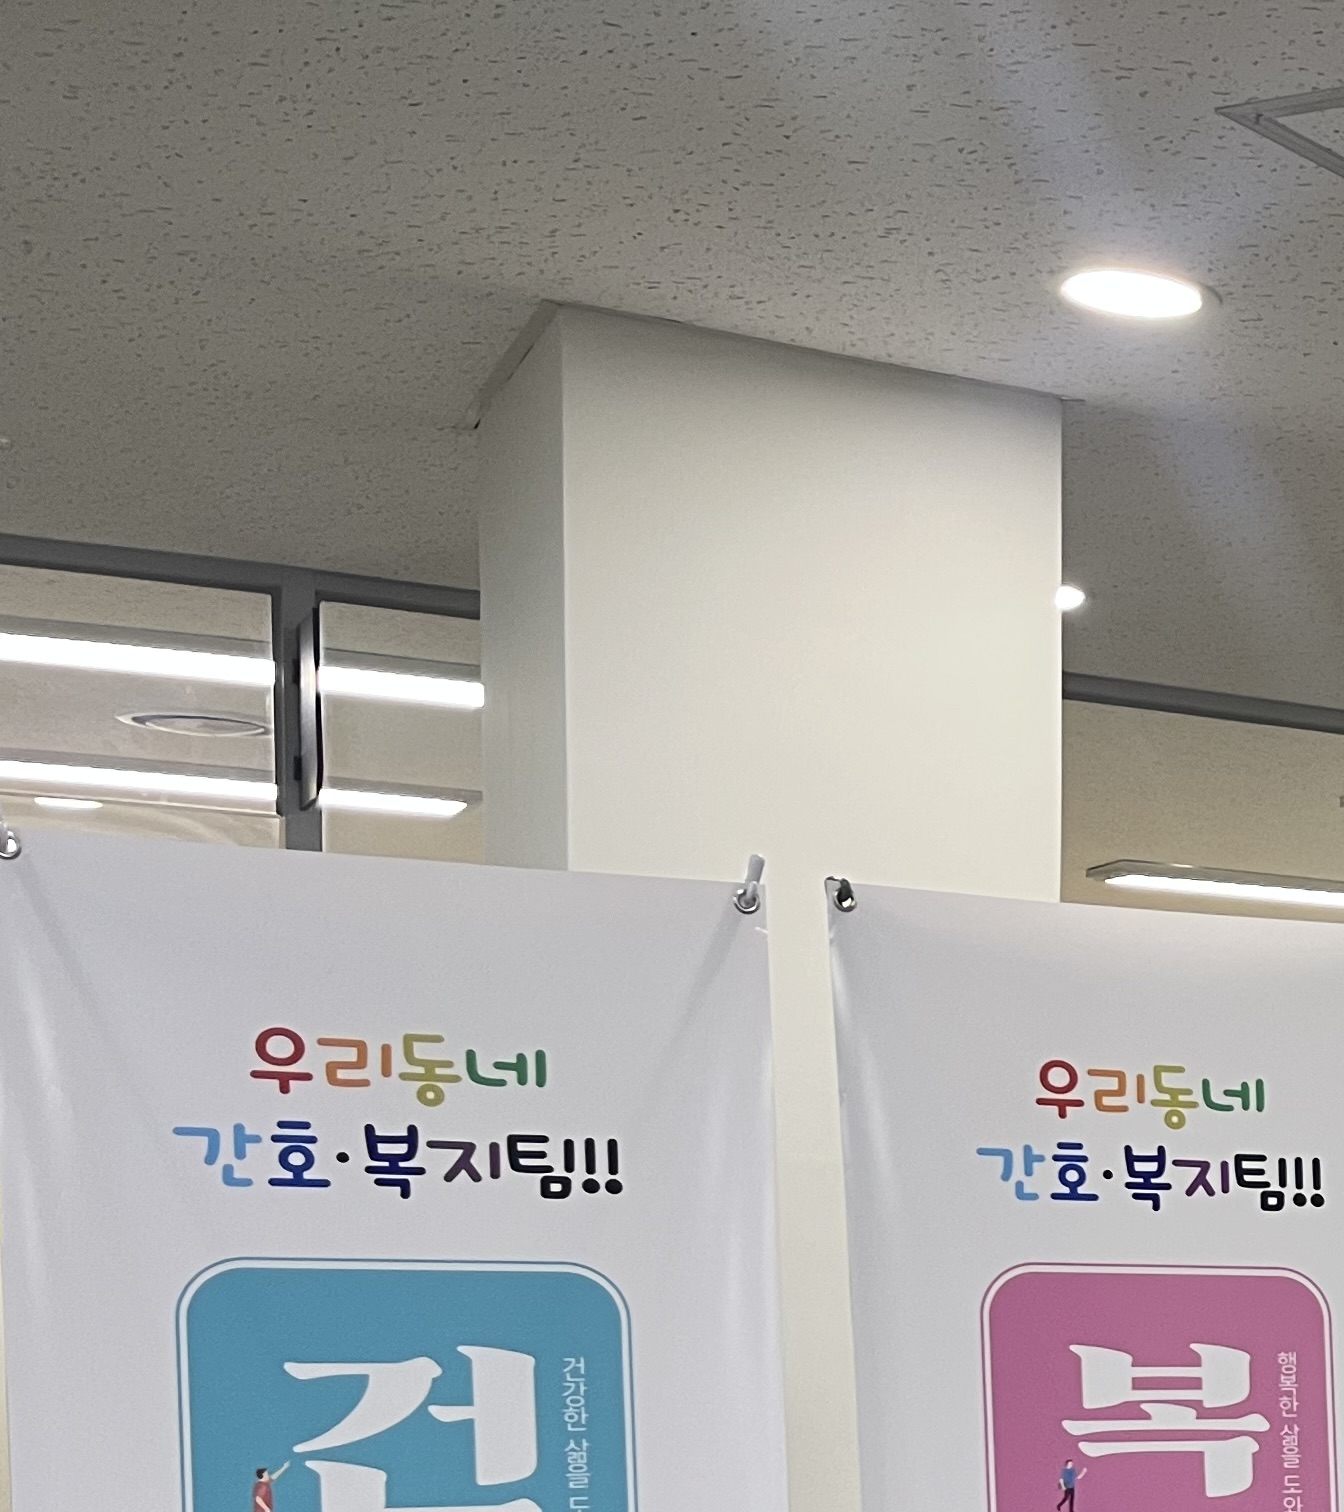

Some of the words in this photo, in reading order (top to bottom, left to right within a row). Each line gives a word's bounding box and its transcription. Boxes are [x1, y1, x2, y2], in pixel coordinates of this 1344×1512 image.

[250, 1027, 547, 1107] 우리동네
[1035, 1060, 1265, 1130] 우리동네
[173, 1121, 624, 1199] 간호·복지팀!!!
[976, 1142, 1325, 1211] 간호·복지팀!!!
[561, 1356, 589, 1432] 건강한
[1277, 1351, 1300, 1418] 행복한
[564, 1438, 591, 1489] 삶을
[1280, 1424, 1301, 1469] 삶을
